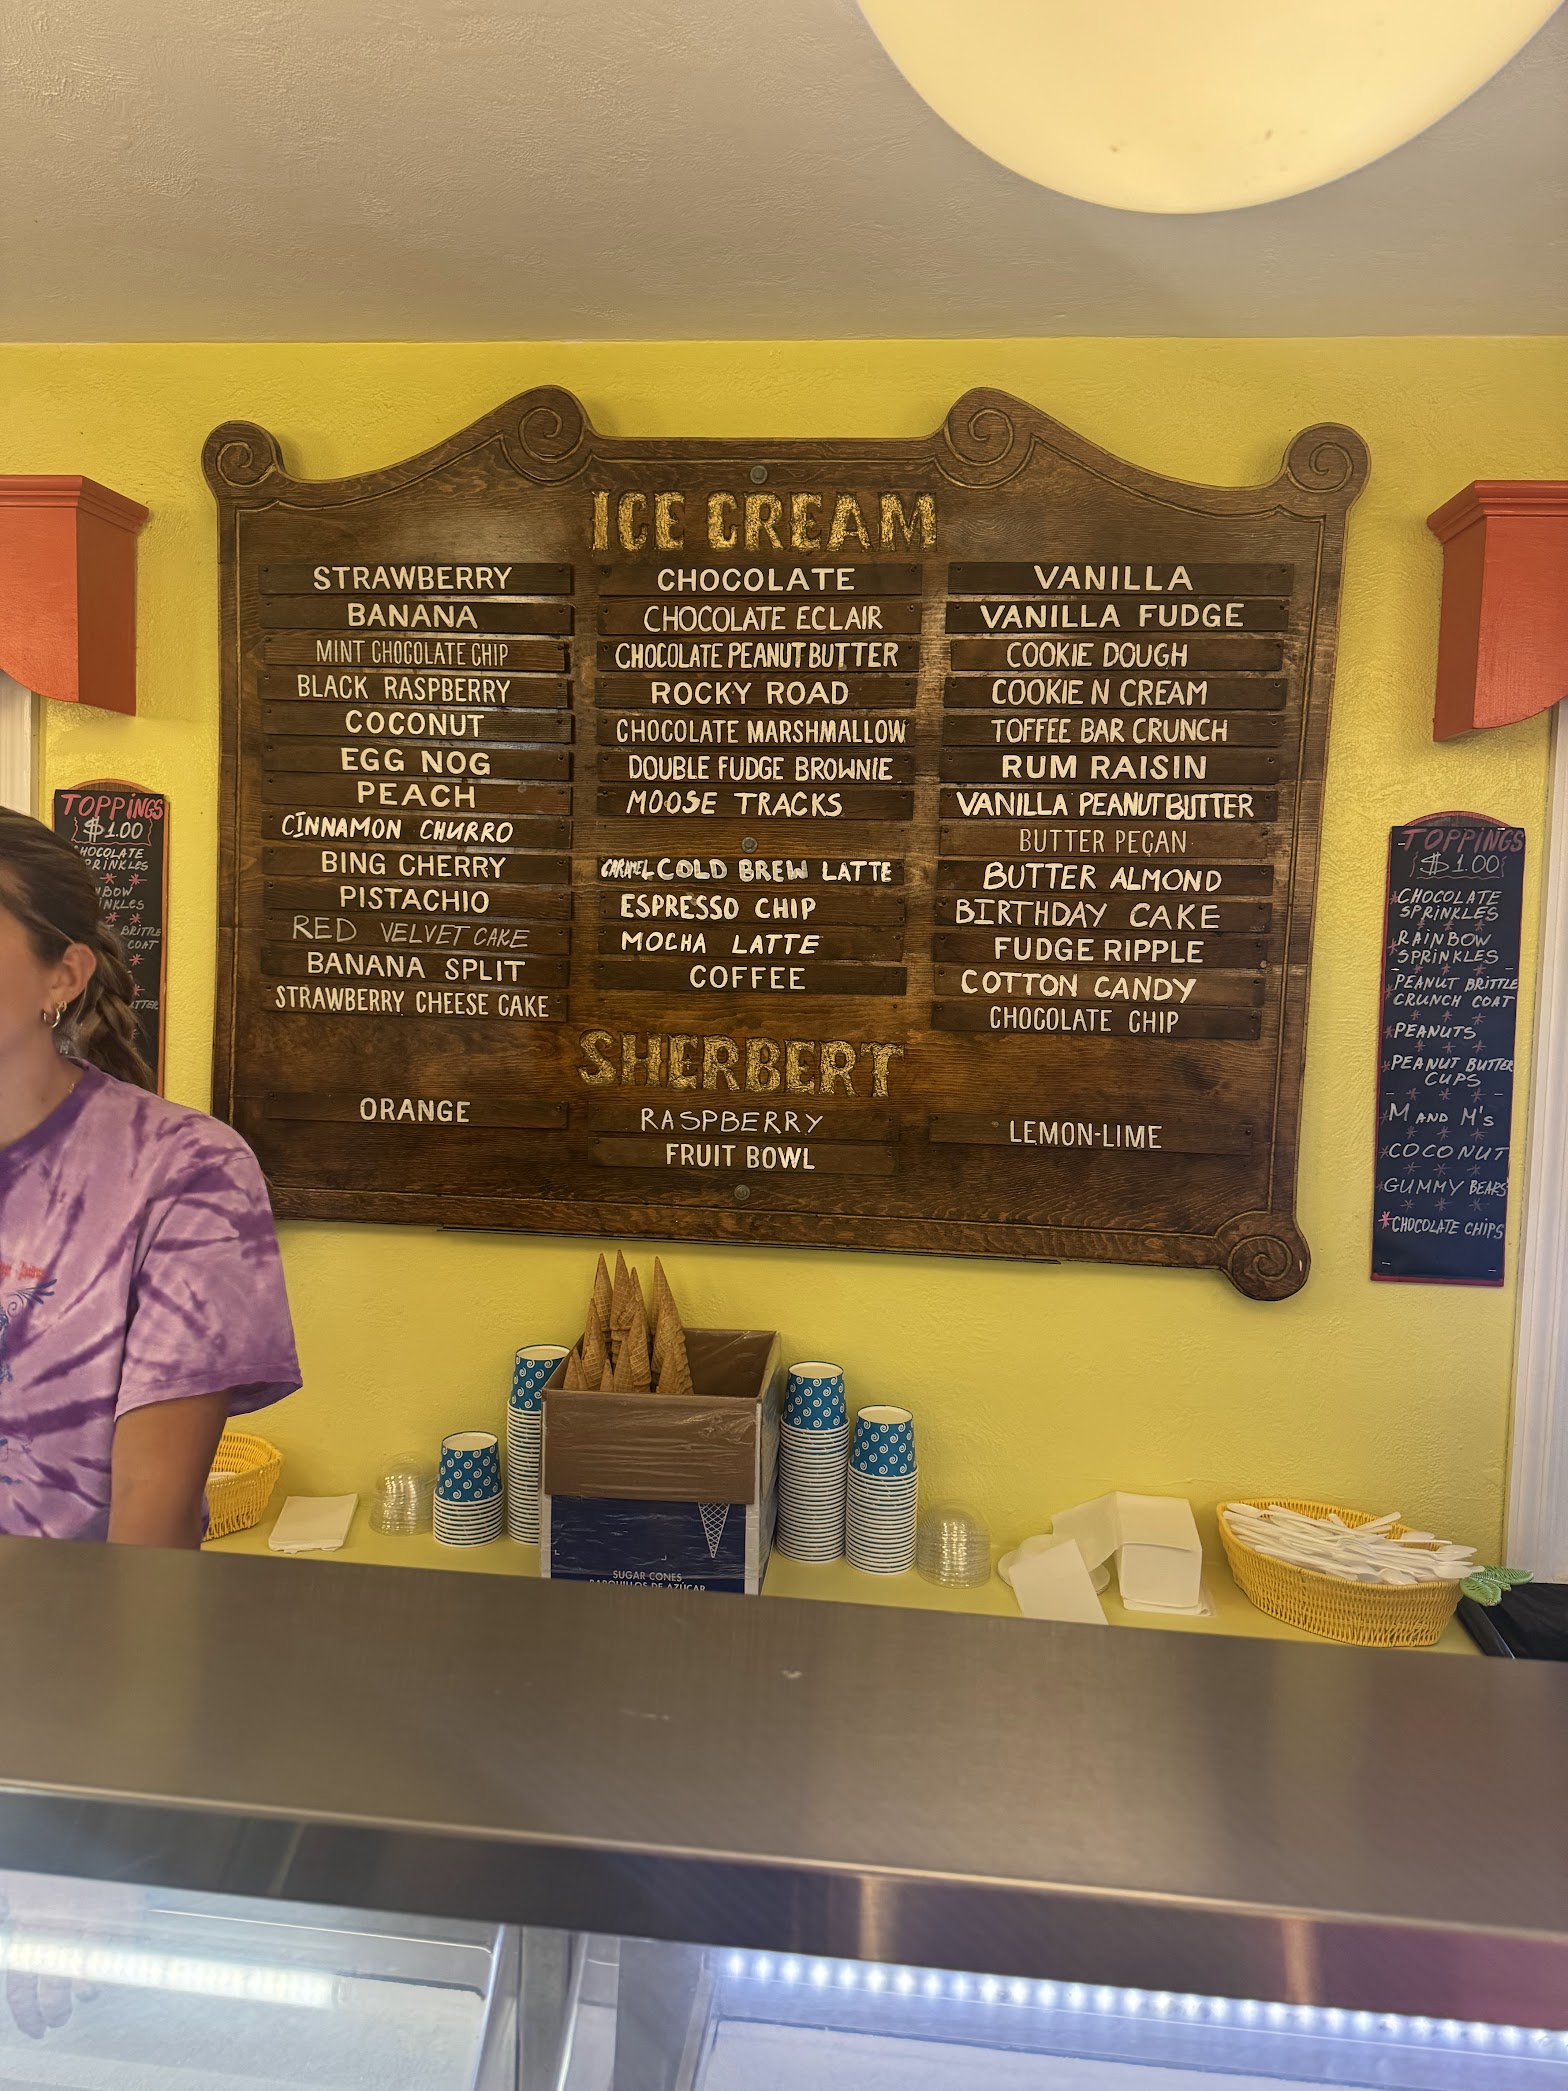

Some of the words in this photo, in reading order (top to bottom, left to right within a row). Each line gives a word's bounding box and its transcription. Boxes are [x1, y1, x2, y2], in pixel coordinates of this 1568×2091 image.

[591, 490, 686, 552] ICE
[707, 491, 938, 552] CREAM
[313, 566, 512, 590] STRAWBERRY
[657, 568, 855, 592] CHOCOLATE
[1034, 565, 1193, 591] VANILLA
[348, 603, 477, 629] BANANA
[643, 605, 786, 632] CHOCOLATE
[797, 606, 883, 630] ECLAIR
[980, 604, 1120, 629] VANILLA
[1139, 603, 1245, 627] FUDGE
[316, 640, 365, 663] MINT
[372, 641, 466, 665] CHOCOLATE
[472, 643, 509, 667] CHIP
[615, 642, 723, 669] CHOCOLATE
[1006, 642, 1094, 668] COOKIE
[1103, 643, 1188, 669] DOUGH
[298, 675, 368, 699] BLACK
[384, 678, 510, 703] RASPBERRY
[651, 681, 751, 705] ROCKY
[767, 681, 848, 705] ROAD
[992, 679, 1083, 705] COOKIE
[1091, 679, 1109, 705] N
[1120, 680, 1208, 706] CREAM
[345, 710, 484, 737] COCONUT
[616, 719, 739, 743] CHOCOLATE
[747, 720, 907, 744] MARSHMALLOW
[992, 718, 1071, 743] TOFFEE
[1080, 719, 1125, 743] BAR
[1133, 719, 1228, 743] CRUNCH
[341, 747, 403, 771] EGG
[422, 751, 490, 775] NOG
[629, 755, 710, 780] DOUBLE
[718, 756, 784, 780] FUDGE
[796, 757, 893, 781] BROWNIE
[1002, 755, 1076, 778] RUM
[1091, 755, 1207, 779] RAISIN
[357, 781, 475, 808] PEACH
[626, 791, 718, 814] MOOSE
[733, 792, 843, 816] TRACKS
[956, 791, 1068, 816] VANILLA
[83, 816, 143, 842] $1.00
[282, 812, 402, 841] CINNAMON
[420, 820, 513, 843] CHURRO
[74, 845, 144, 859] HOCOLATE
[1020, 829, 1105, 853] BUTTER
[1116, 830, 1186, 856] PECAN
[321, 851, 386, 875] BING
[399, 853, 506, 878] CHERRY
[655, 858, 727, 880] COLD
[739, 859, 809, 883] BREW
[822, 861, 891, 882] LATTE
[983, 862, 1096, 890] BUTTER
[1110, 866, 1222, 891] ALMOND
[340, 886, 489, 913] PISTACHIO
[621, 894, 739, 920] ESPRESSO
[755, 897, 817, 920] CHIP
[1397, 888, 1501, 905] CHOCOLATE
[956, 899, 1108, 927] BIRTHDAY
[1130, 903, 1220, 930] CAKE
[128, 940, 159, 949] COAT
[293, 915, 357, 942] RED
[381, 922, 470, 946] VELVET
[474, 927, 530, 948] CAKE
[621, 931, 706, 953] MOCHA
[732, 934, 820, 954] LATTE
[994, 937, 1094, 961] FUDGE
[1104, 939, 1204, 964] RIPPLE
[308, 952, 426, 978] BANANA
[445, 958, 525, 981] SPLIT
[690, 965, 805, 990] COFFEE
[961, 970, 1078, 997] COTTON
[1094, 977, 1197, 1003] CANDY
[1394, 974, 1460, 991] PEANUT
[275, 986, 404, 1013] STRAWBERRY
[416, 991, 488, 1015] CHEESE
[498, 994, 549, 1018] CAKE
[1393, 993, 1462, 1007] CRUNCH
[1472, 995, 1515, 1008] COAT
[990, 1006, 1112, 1032] CHOCOLATE
[1129, 1010, 1179, 1034] CHIP
[1394, 1022, 1477, 1039] PEANUTS
[578, 1029, 905, 1097] SHERBERT
[1391, 1055, 1460, 1071] PEANUT
[1466, 1057, 1513, 1072] BUTTER
[1425, 1072, 1481, 1087] CUPS
[360, 1097, 471, 1123] ORANGE
[641, 1108, 824, 1134] RASPBERRY
[1389, 1103, 1410, 1121] M
[1416, 1113, 1448, 1124] AND
[1010, 1121, 1163, 1148] LEMON-LIME
[666, 1144, 736, 1167] FRUIT
[747, 1146, 815, 1170] BOWL
[1388, 1143, 1509, 1160] COCONUT
[1384, 1178, 1464, 1196] GUMMY
[1392, 1216, 1460, 1234] CHOCOLATE
[613, 1570, 645, 1580] SUGAR
[649, 1572, 682, 1581] CONES
